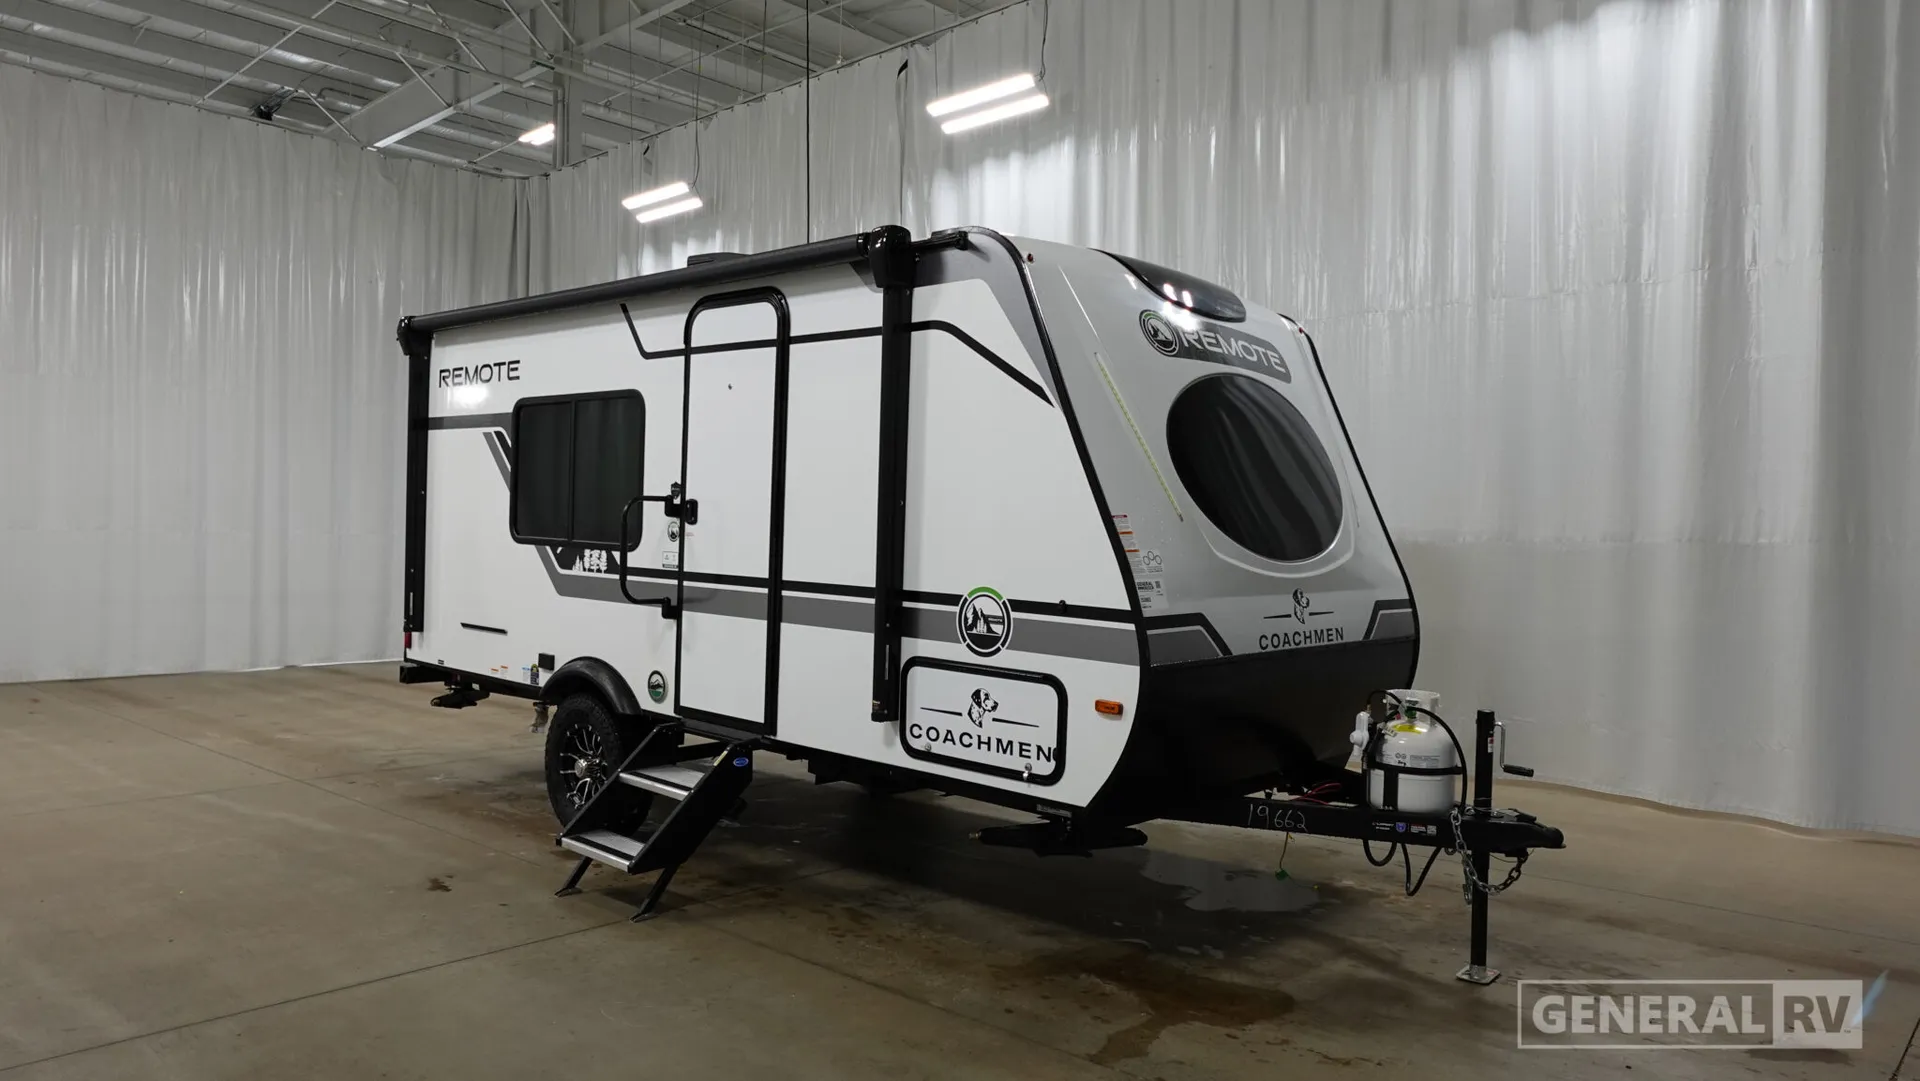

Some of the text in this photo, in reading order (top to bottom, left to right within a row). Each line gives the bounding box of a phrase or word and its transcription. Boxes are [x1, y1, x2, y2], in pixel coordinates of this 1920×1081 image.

[1179, 330, 1286, 373] REMOTE
[439, 360, 521, 388] REMOTE
[1259, 627, 1344, 650] COACHMEN
[909, 723, 1052, 763] COACHMEN
[1247, 803, 1309, 832] 19662
